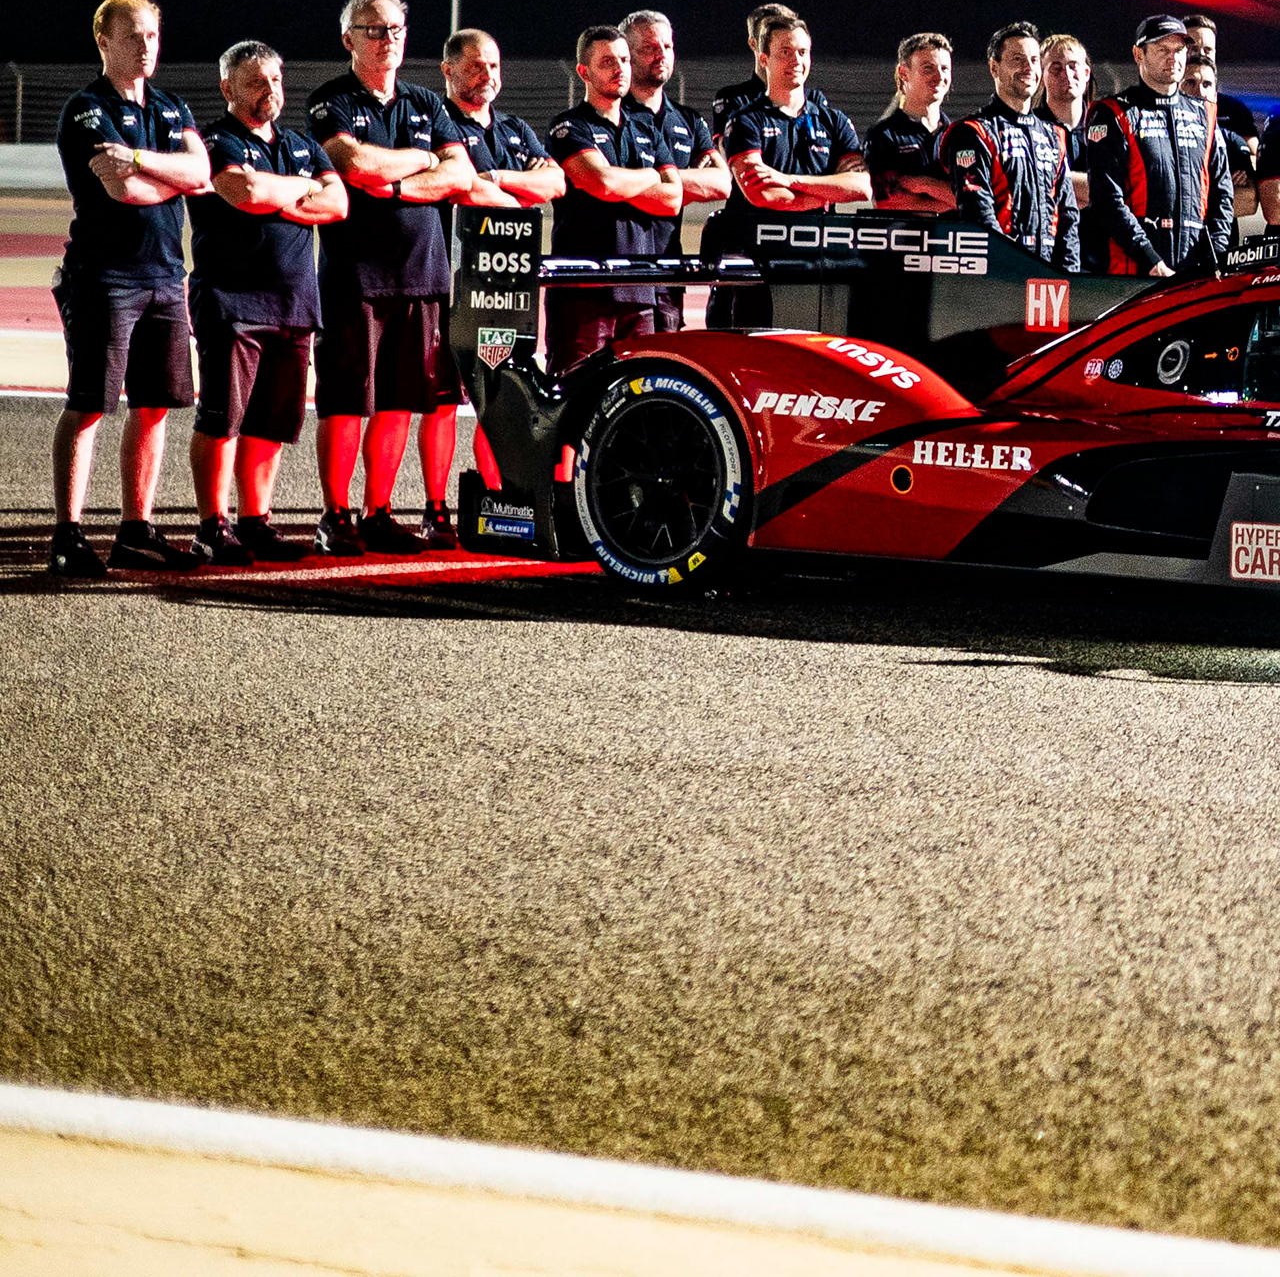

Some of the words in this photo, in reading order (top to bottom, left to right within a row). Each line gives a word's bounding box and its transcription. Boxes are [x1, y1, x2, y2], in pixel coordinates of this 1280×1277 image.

[479, 217, 533, 240] Ansys
[756, 225, 989, 254] PORSCHE
[478, 252, 531, 273] BOSS
[904, 255, 988, 274] 963
[1227, 247, 1263, 266] Mobil
[470, 290, 513, 310] Mobil
[1028, 284, 1068, 327] HY
[481, 331, 513, 345] TAG
[480, 345, 511, 367] HEUER
[806, 336, 921, 389] Ansys
[1085, 361, 1102, 375] FIA
[655, 378, 717, 415] MICHELIN
[751, 391, 886, 423] PENSKE
[912, 440, 1032, 471] HELLER
[493, 502, 534, 517] Multimatic
[494, 523, 530, 534] MICHELIN
[596, 545, 655, 584] MICHELIN
